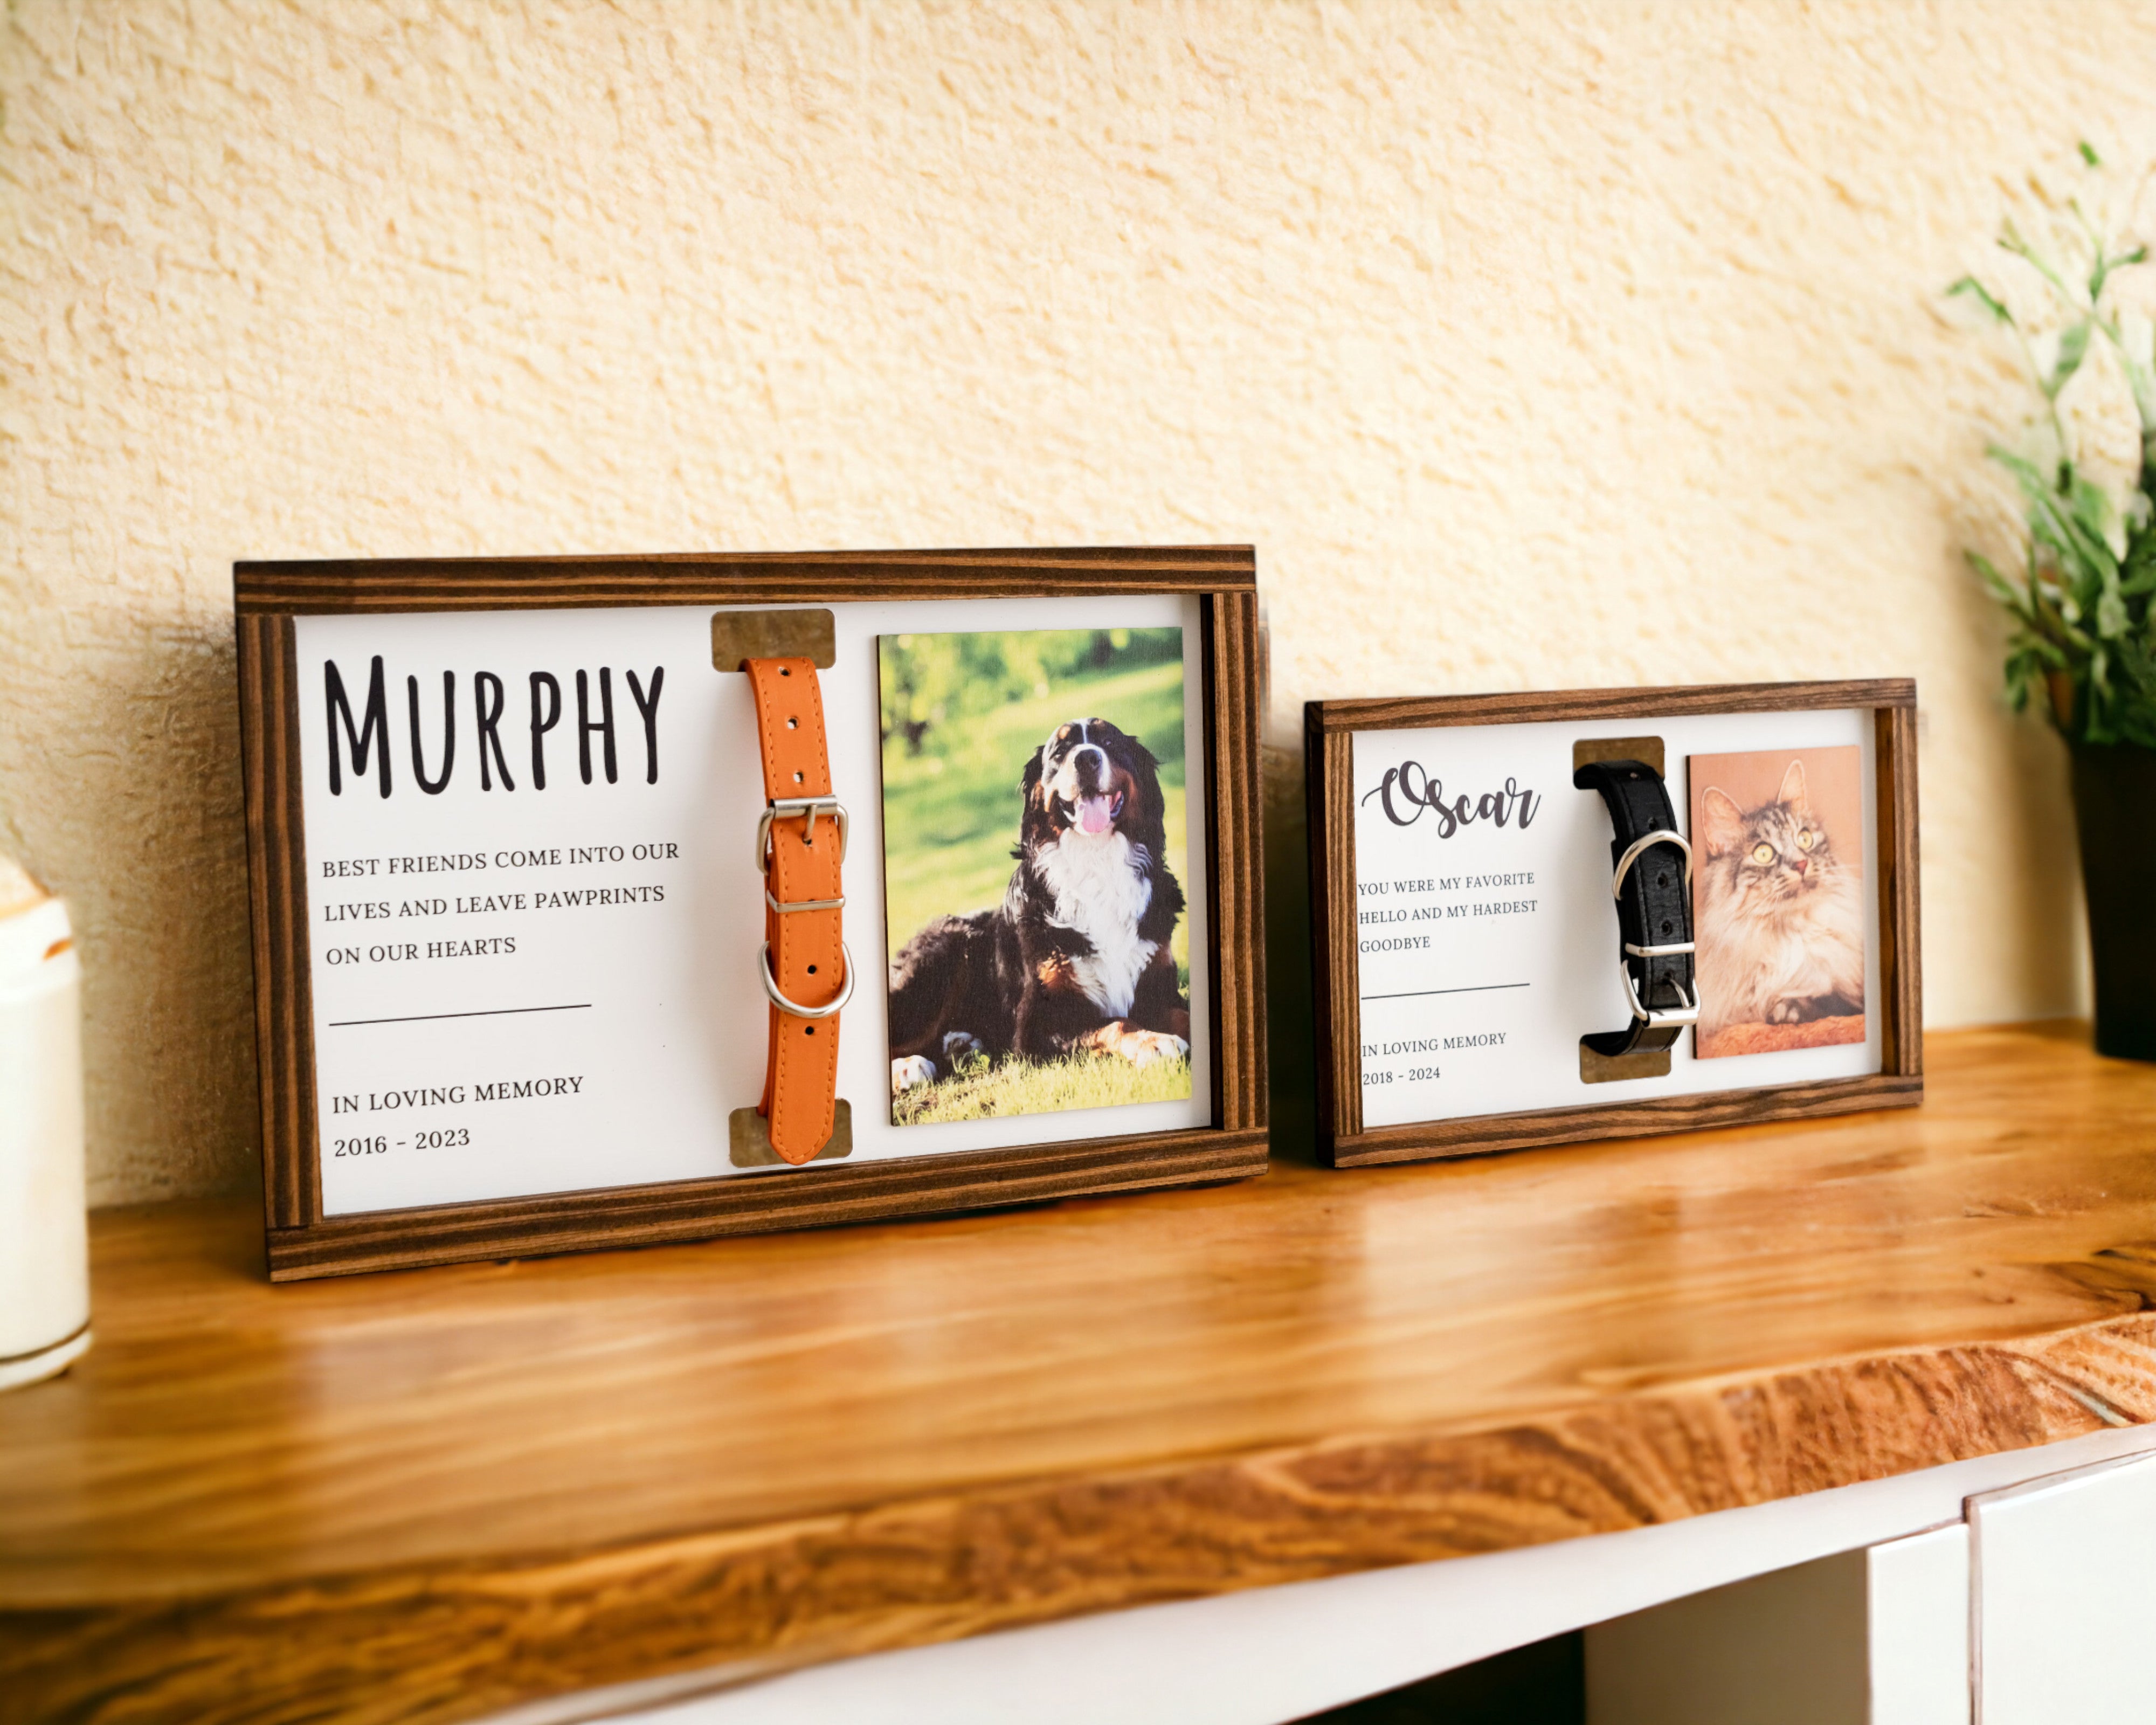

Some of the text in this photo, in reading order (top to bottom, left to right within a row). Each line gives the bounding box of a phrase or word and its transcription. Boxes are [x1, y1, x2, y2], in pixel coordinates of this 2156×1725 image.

[1361, 760, 1542, 839] Oscar
[322, 843, 680, 878] BEST FRIENDS COME INTO OUR
[1358, 872, 1535, 895] YOU WERE MY FAVORITE
[324, 885, 665, 922] LIVES AND LEAVE PAWPRINTS
[1359, 900, 1538, 924] HELLO AND MY HARDEST
[326, 937, 516, 965] ON OUR HEARTS
[1360, 936, 1431, 953] GOODBYE
[1362, 1032, 1507, 1057] IN LOVING MEMORY
[1363, 1071, 1393, 1086] 2018
[1408, 1066, 1440, 1081] 2024
[333, 1076, 584, 1114] IN LOVING MEMORY
[334, 1136, 387, 1157] 2016
[416, 1128, 470, 1149] 2023
